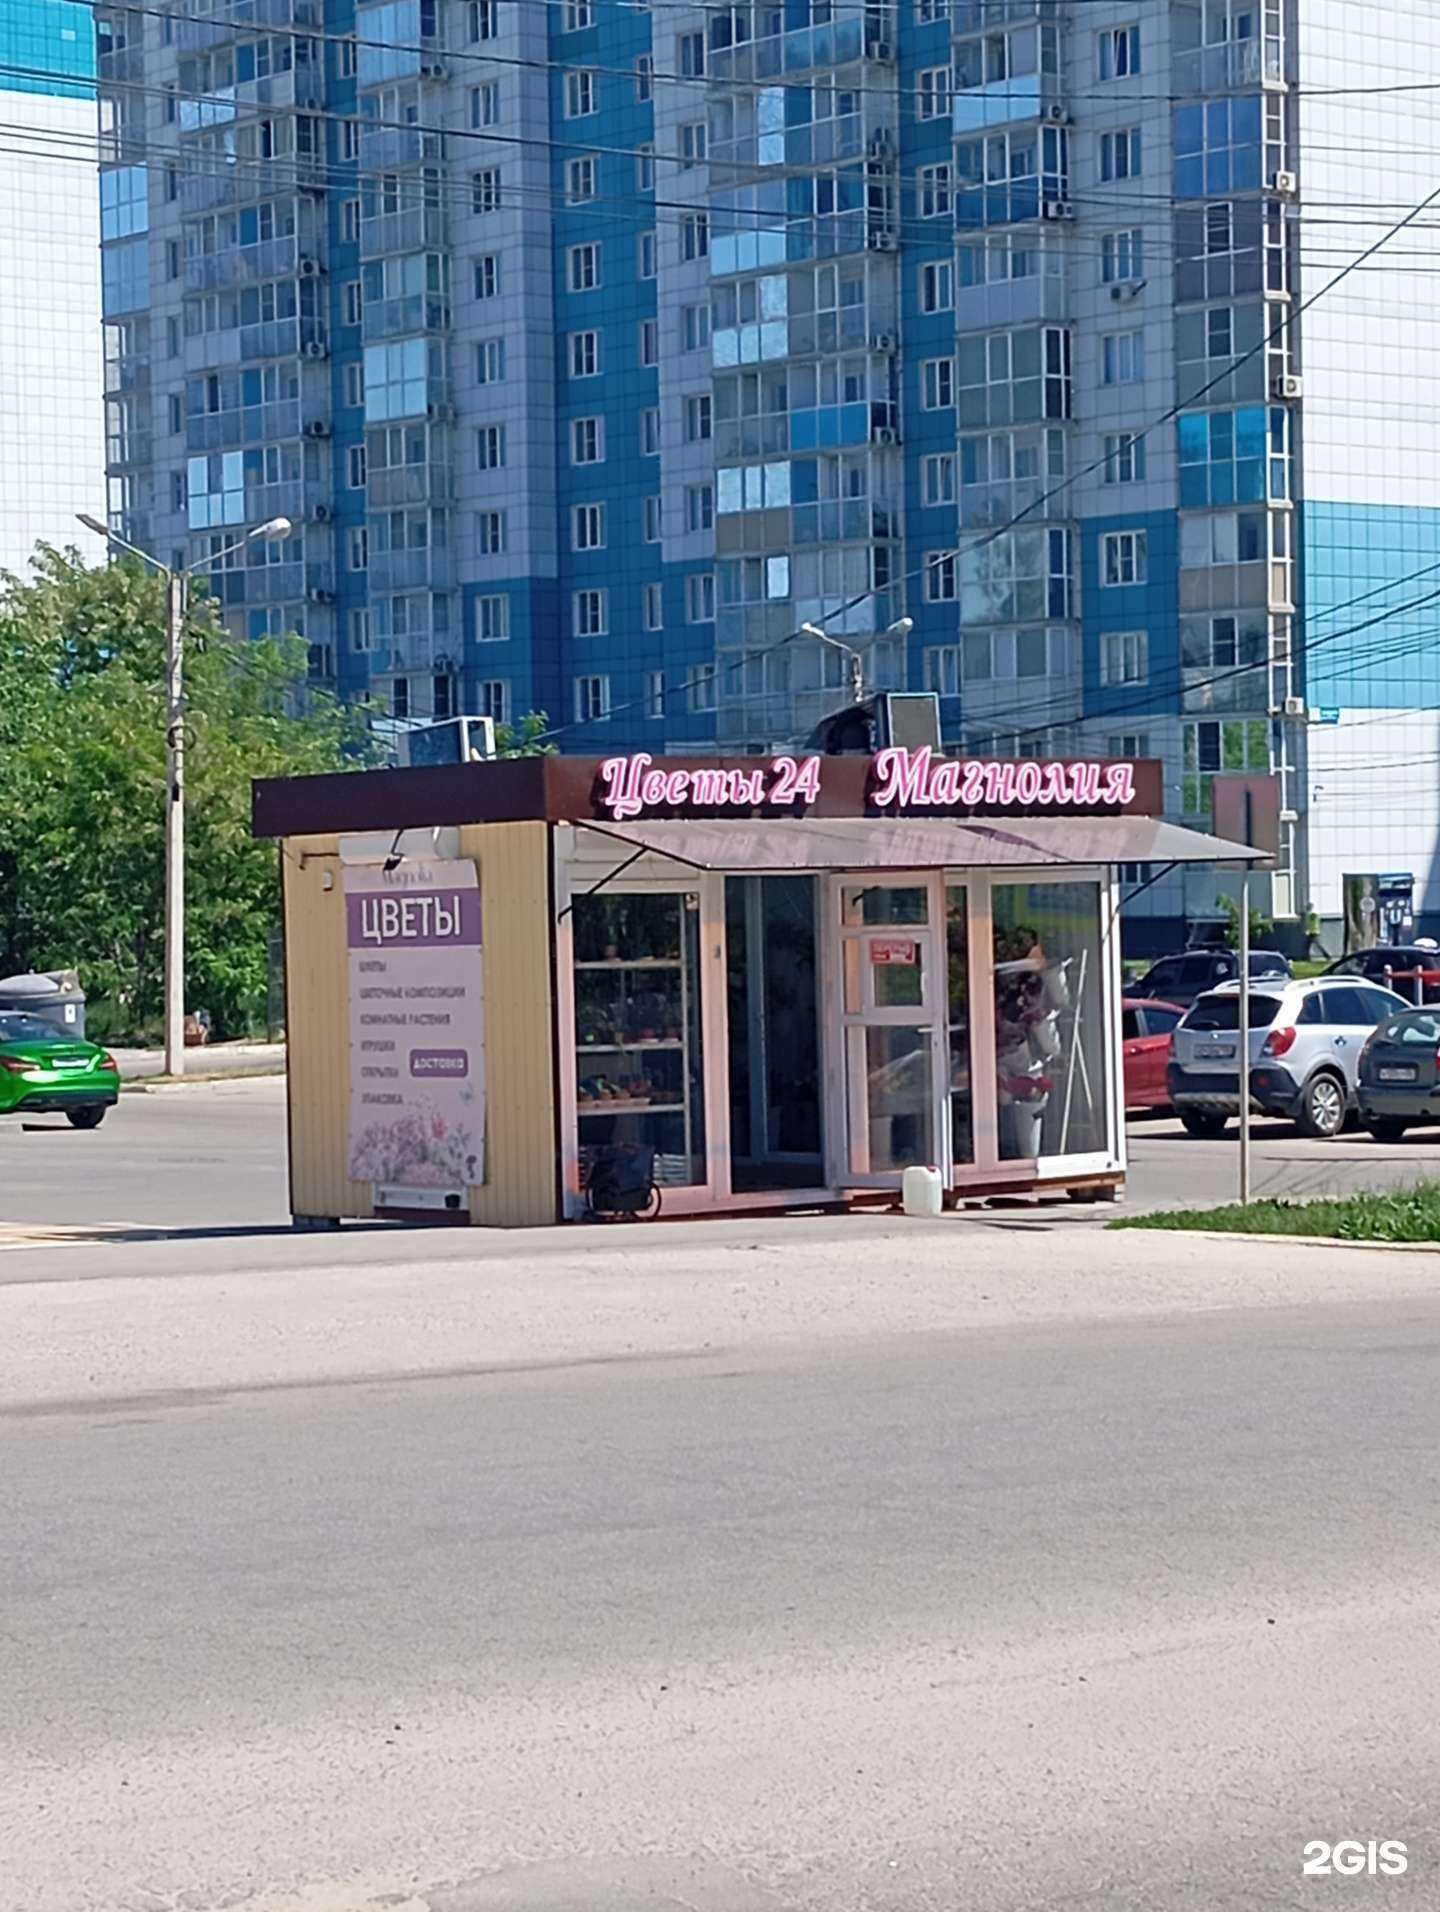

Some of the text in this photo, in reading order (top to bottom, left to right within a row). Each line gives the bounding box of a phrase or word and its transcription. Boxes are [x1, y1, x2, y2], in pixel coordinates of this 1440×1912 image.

[600, 753, 821, 820] Цветы 24
[871, 745, 1137, 807] Магнолия
[361, 895, 461, 945] ЦВЕТЫ
